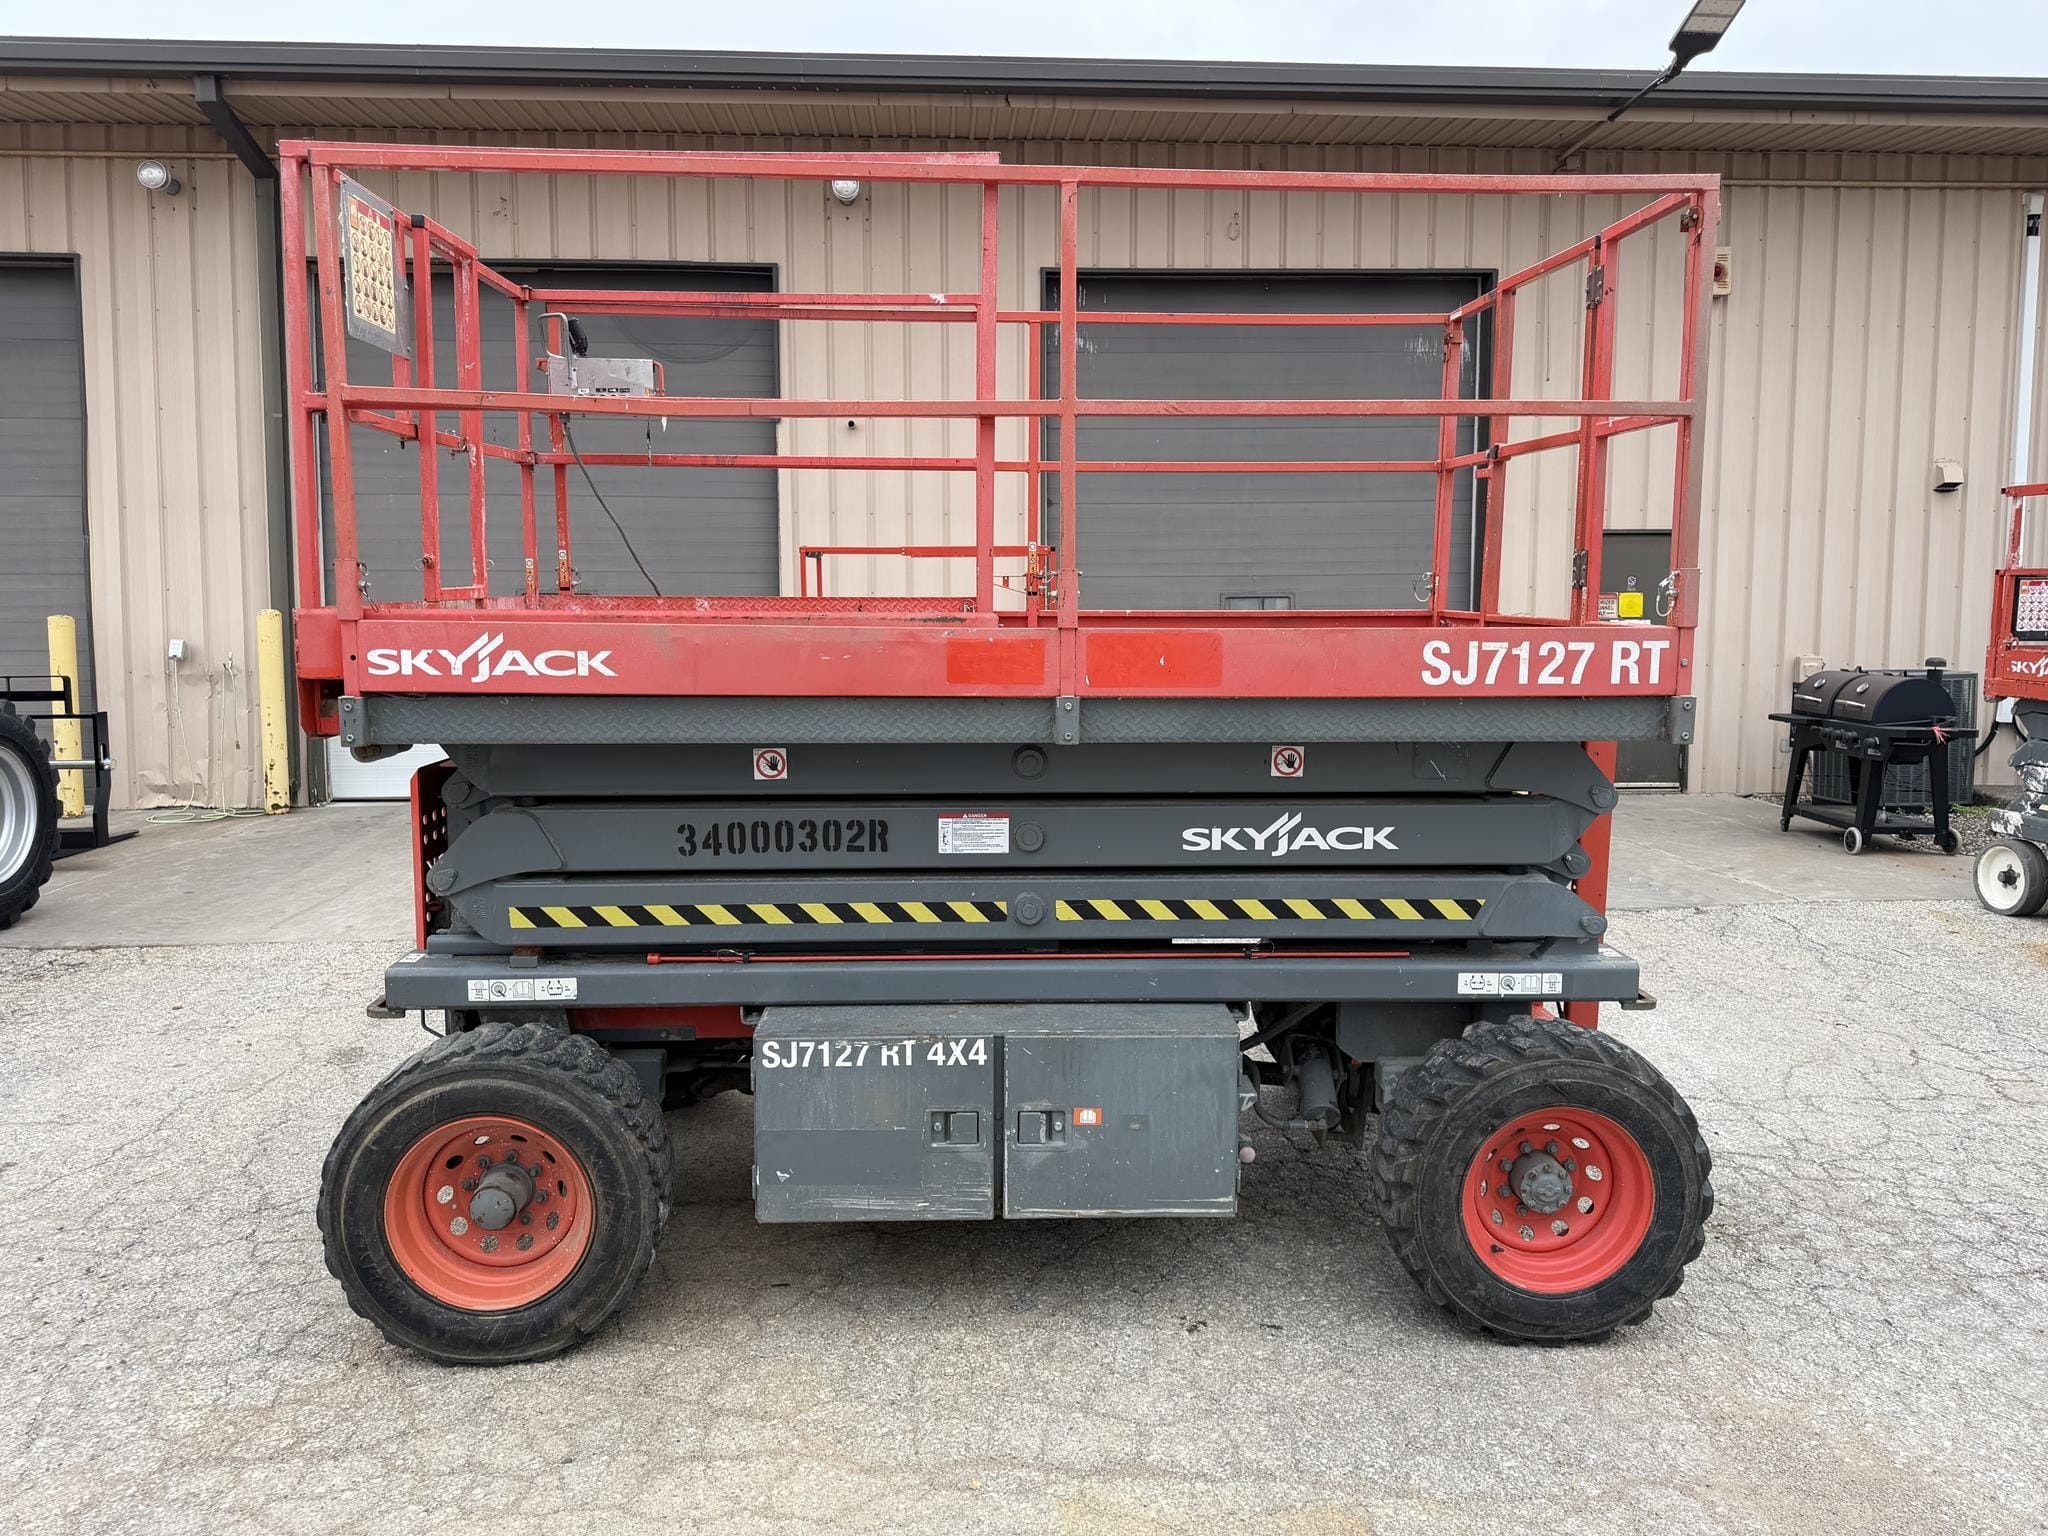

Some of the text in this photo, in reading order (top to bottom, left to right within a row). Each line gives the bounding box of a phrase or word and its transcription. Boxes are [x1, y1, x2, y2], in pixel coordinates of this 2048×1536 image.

[366, 632, 619, 683] SKYJACK
[1421, 639, 1671, 686] SJ7127 RT
[2010, 655, 2048, 678] SKYJ
[677, 819, 889, 857] 34000302R
[1181, 811, 1399, 857] SKYJACK
[761, 1038, 988, 1069] SJ7127 RT 4X4
